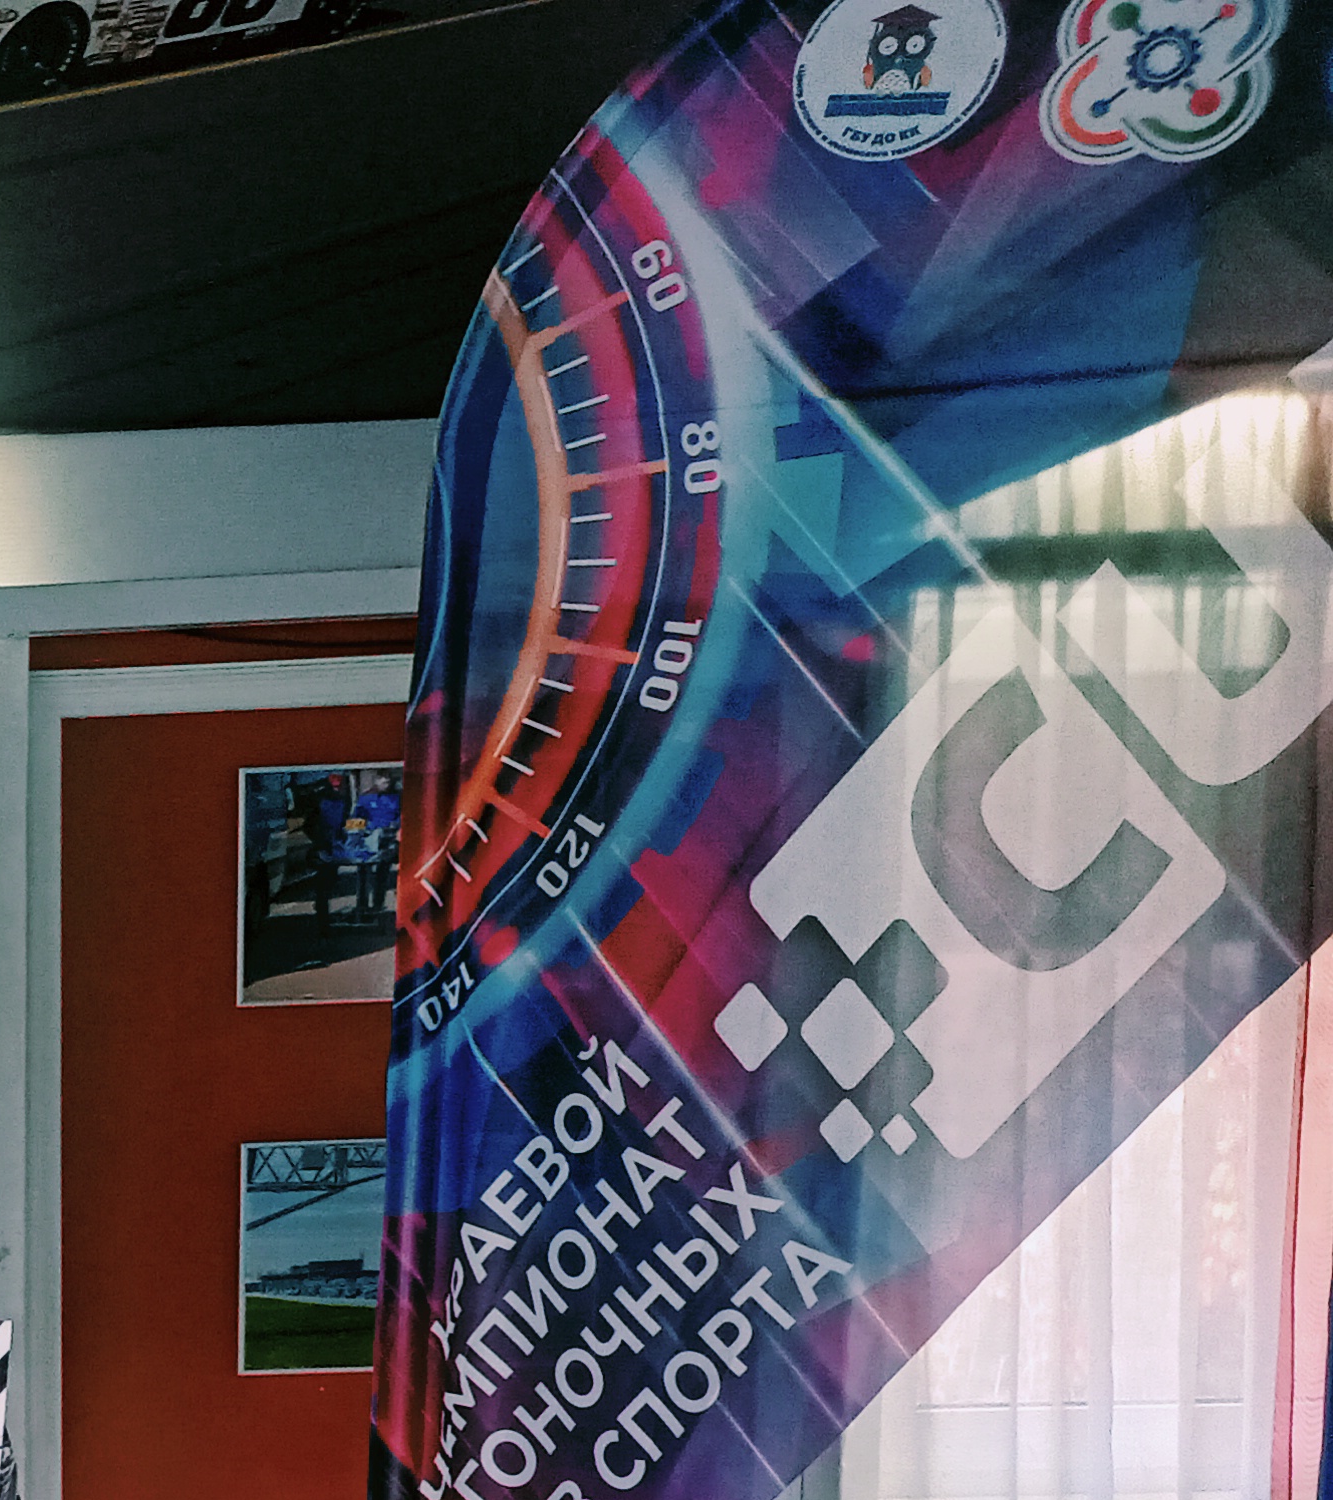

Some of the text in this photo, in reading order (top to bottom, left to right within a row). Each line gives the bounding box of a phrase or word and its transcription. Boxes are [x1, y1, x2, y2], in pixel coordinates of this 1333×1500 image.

[841, 126, 871, 143] ГБУ
[871, 132, 896, 146] ДО
[630, 238, 691, 313] 60
[681, 419, 724, 495] 80
[638, 616, 704, 712] 100
[535, 815, 607, 901] 120
[416, 961, 477, 1035] 140
[430, 1035, 651, 1361] КРАЕВОЙ
[592, 1238, 853, 1491] СПОРТА
